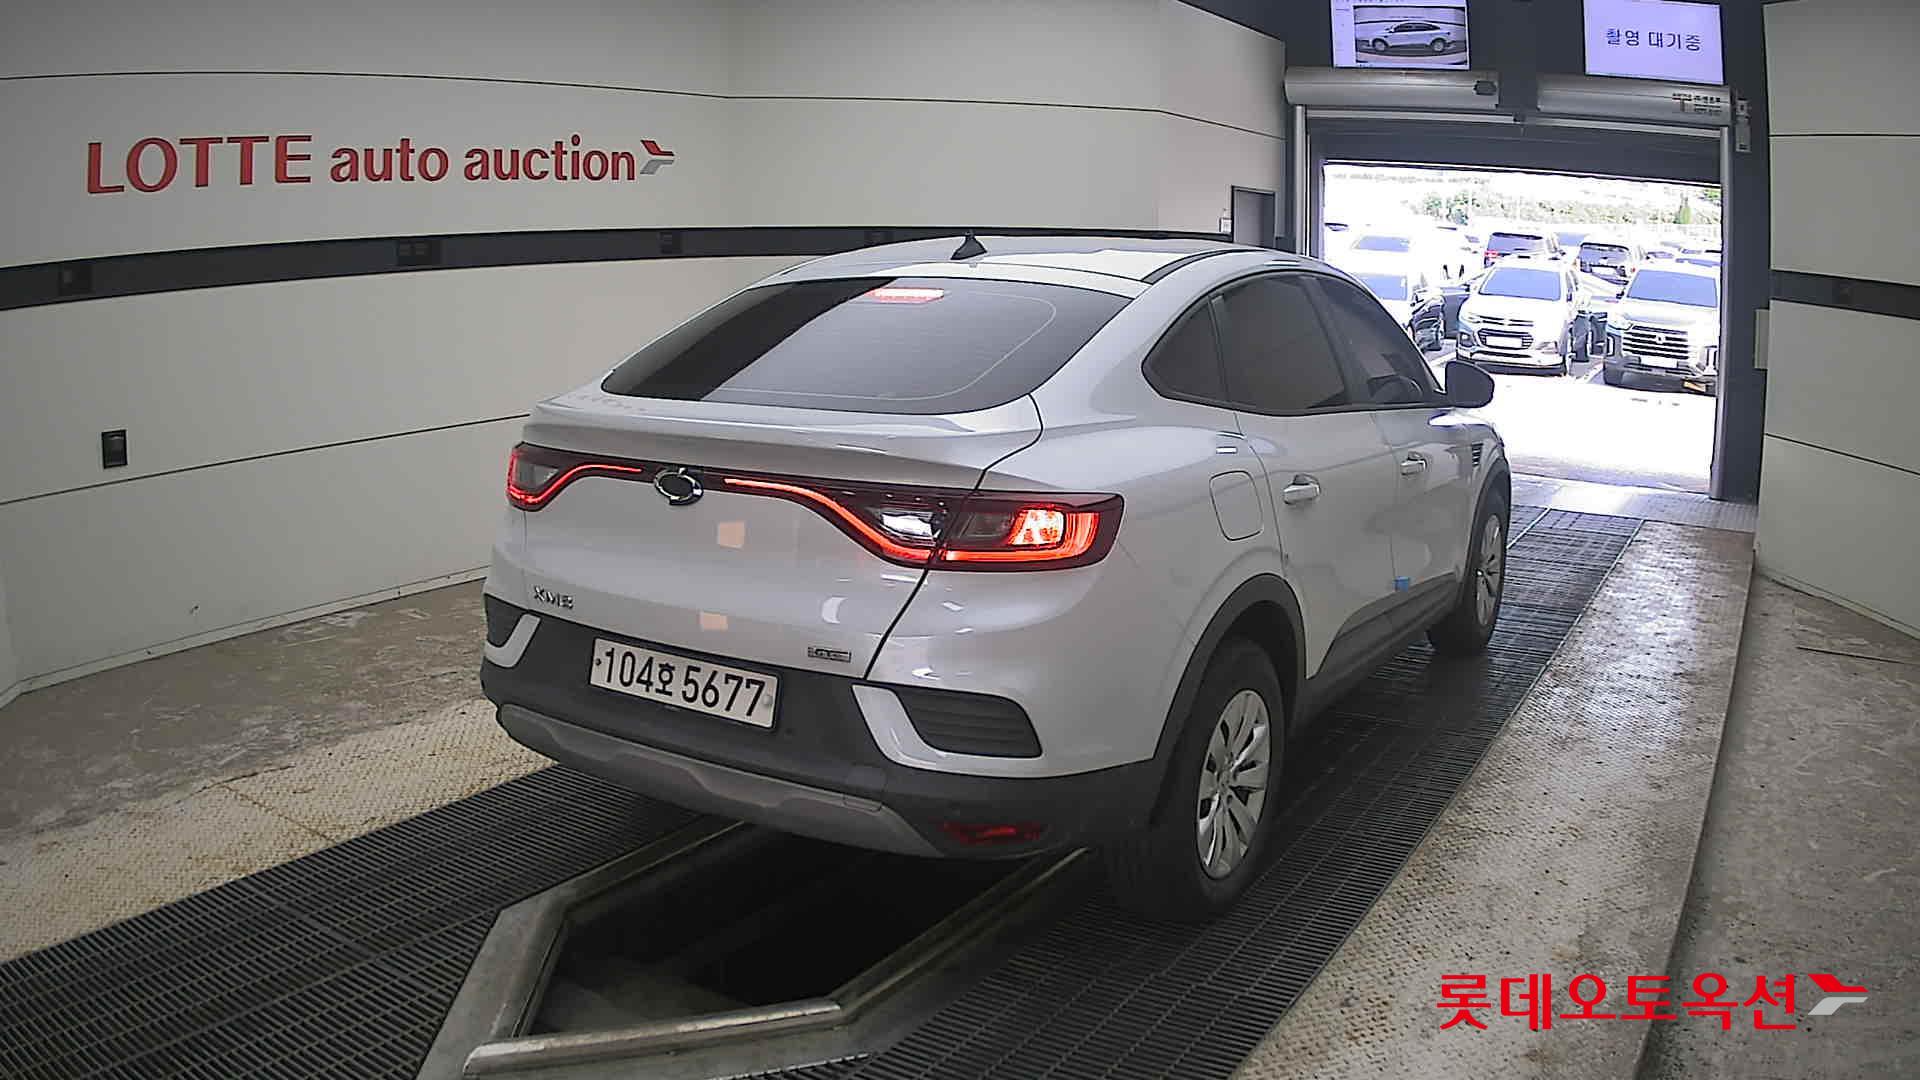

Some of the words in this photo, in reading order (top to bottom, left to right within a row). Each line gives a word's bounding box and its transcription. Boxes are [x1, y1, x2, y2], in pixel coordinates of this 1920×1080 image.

[1648, 31, 1701, 52] 대기중
[87, 134, 312, 194] LOTTE
[330, 137, 450, 183] auto
[463, 133, 636, 182] auction
[605, 647, 676, 697] 104호
[681, 665, 766, 717] 5677
